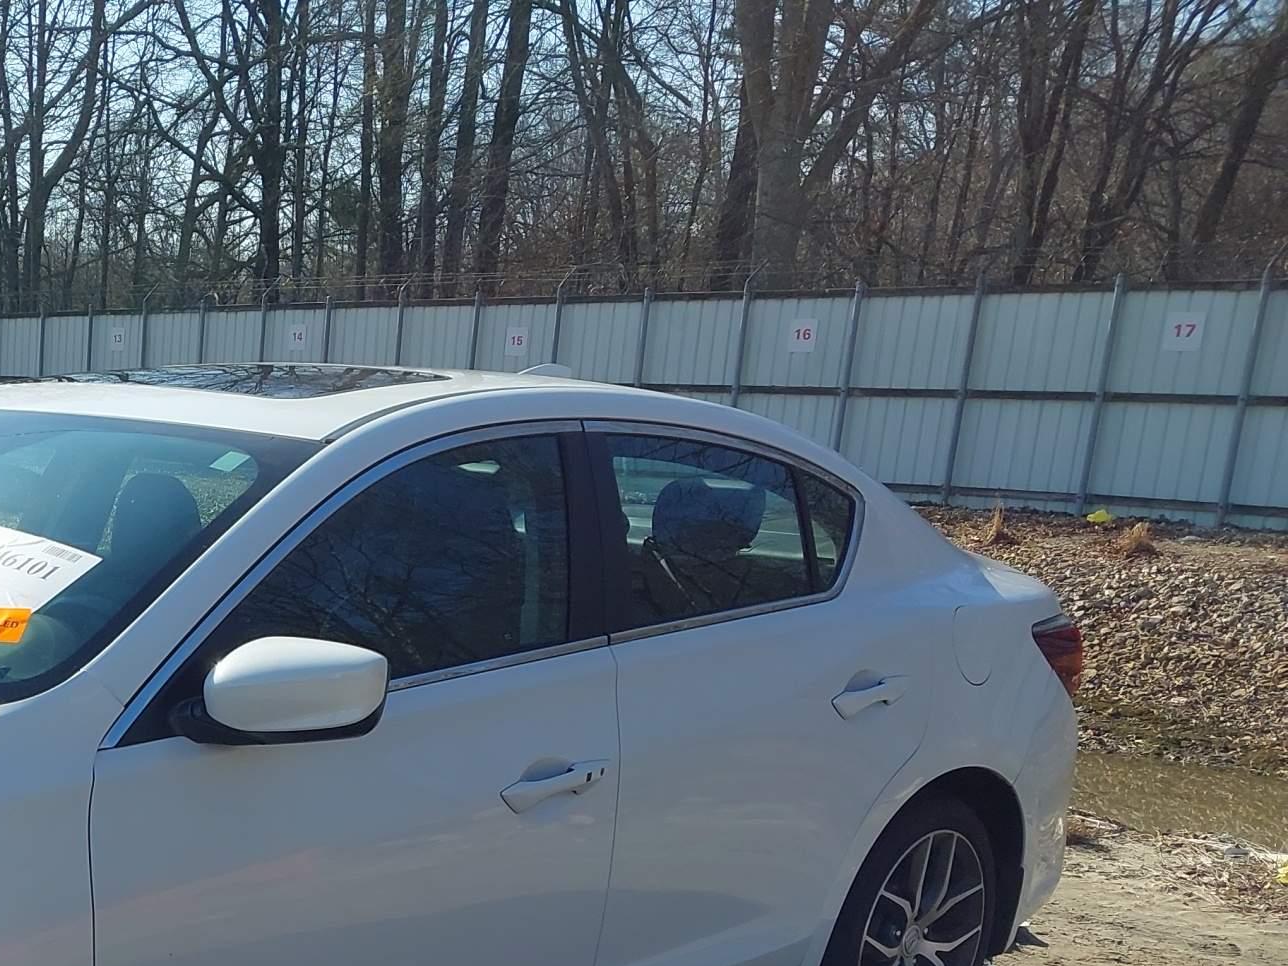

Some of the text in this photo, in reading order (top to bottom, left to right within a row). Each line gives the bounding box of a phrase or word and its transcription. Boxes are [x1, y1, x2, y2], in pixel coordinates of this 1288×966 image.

[292, 332, 303, 341] 14
[793, 328, 812, 341] 16
[1174, 324, 1197, 338] 17
[113, 334, 122, 343] 13
[511, 335, 523, 346] 15
